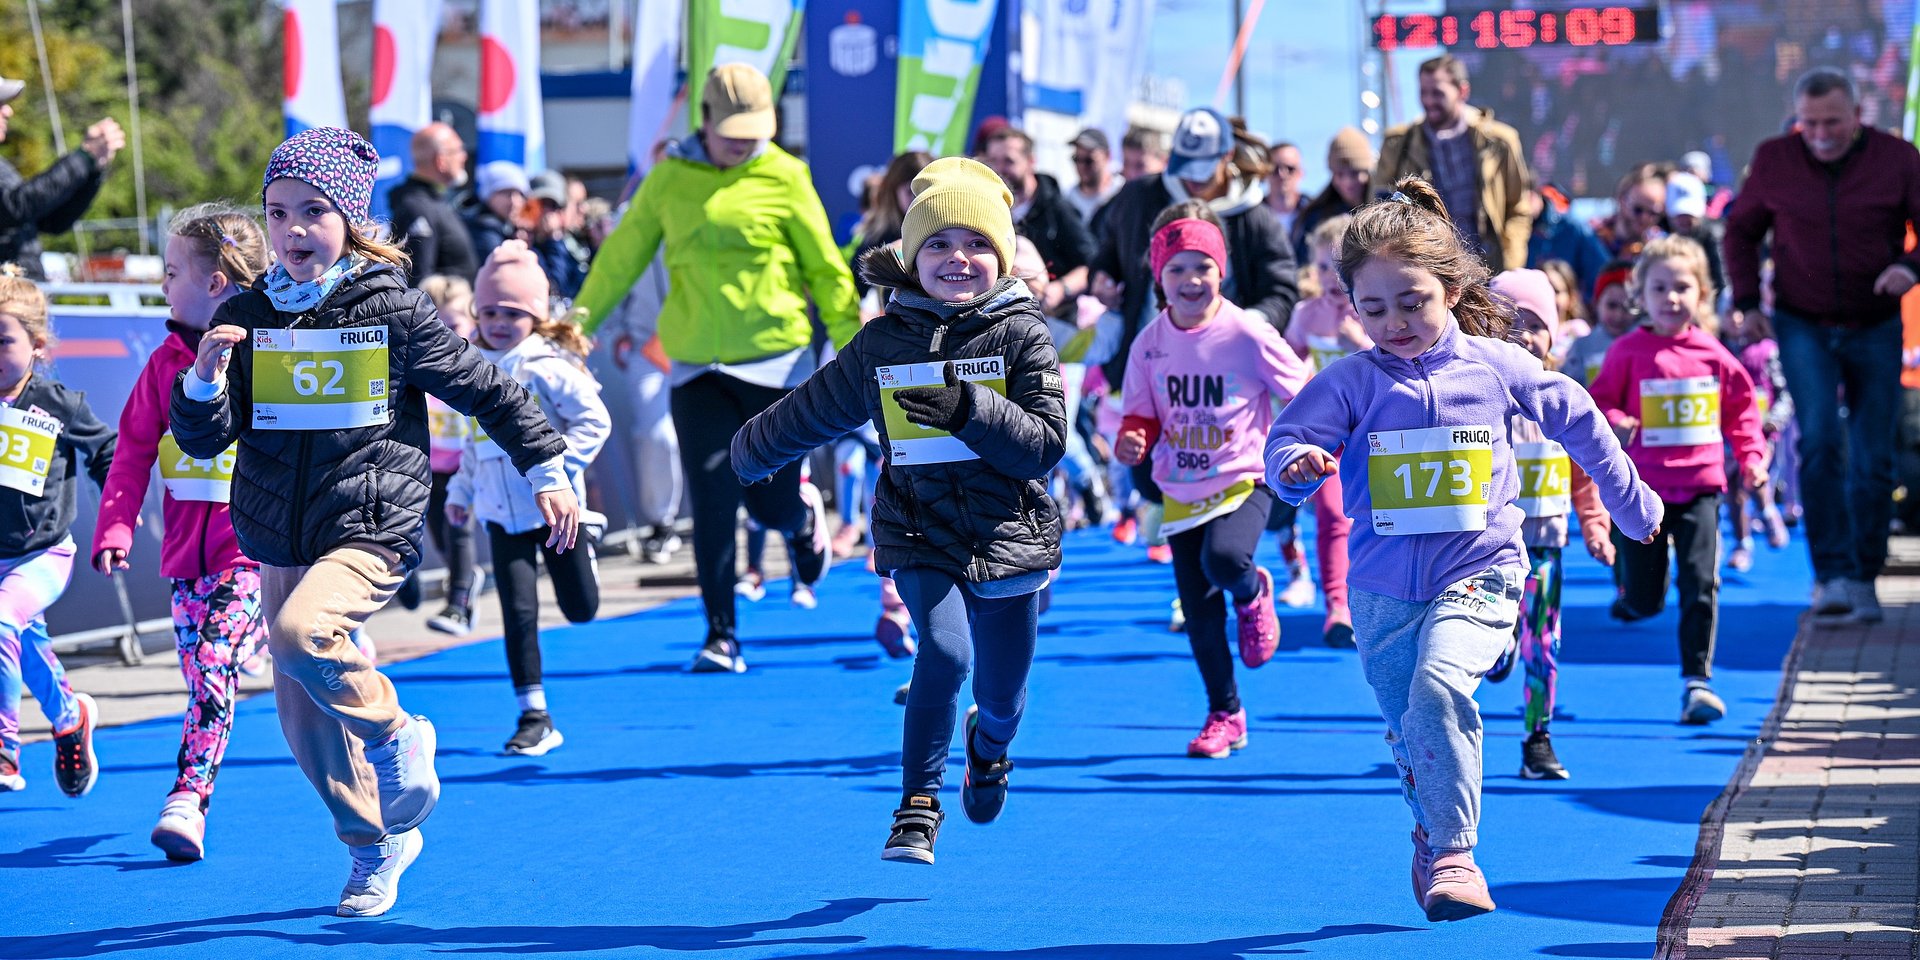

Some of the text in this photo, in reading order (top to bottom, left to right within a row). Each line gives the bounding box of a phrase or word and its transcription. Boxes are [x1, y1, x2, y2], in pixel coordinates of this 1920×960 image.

[1374, 7, 1636, 51] 12:15:09
[340, 330, 383, 344] FRUGO
[293, 360, 345, 396] 62
[955, 361, 1000, 376] FRUGO
[1167, 374, 1223, 409] RUN
[22, 415, 55, 433] FRUGO
[1662, 397, 1708, 424] 192
[1167, 425, 1223, 450] WILD
[1452, 430, 1490, 444] FRUGO
[1393, 459, 1473, 499] 173
[1517, 463, 1560, 492] 174
